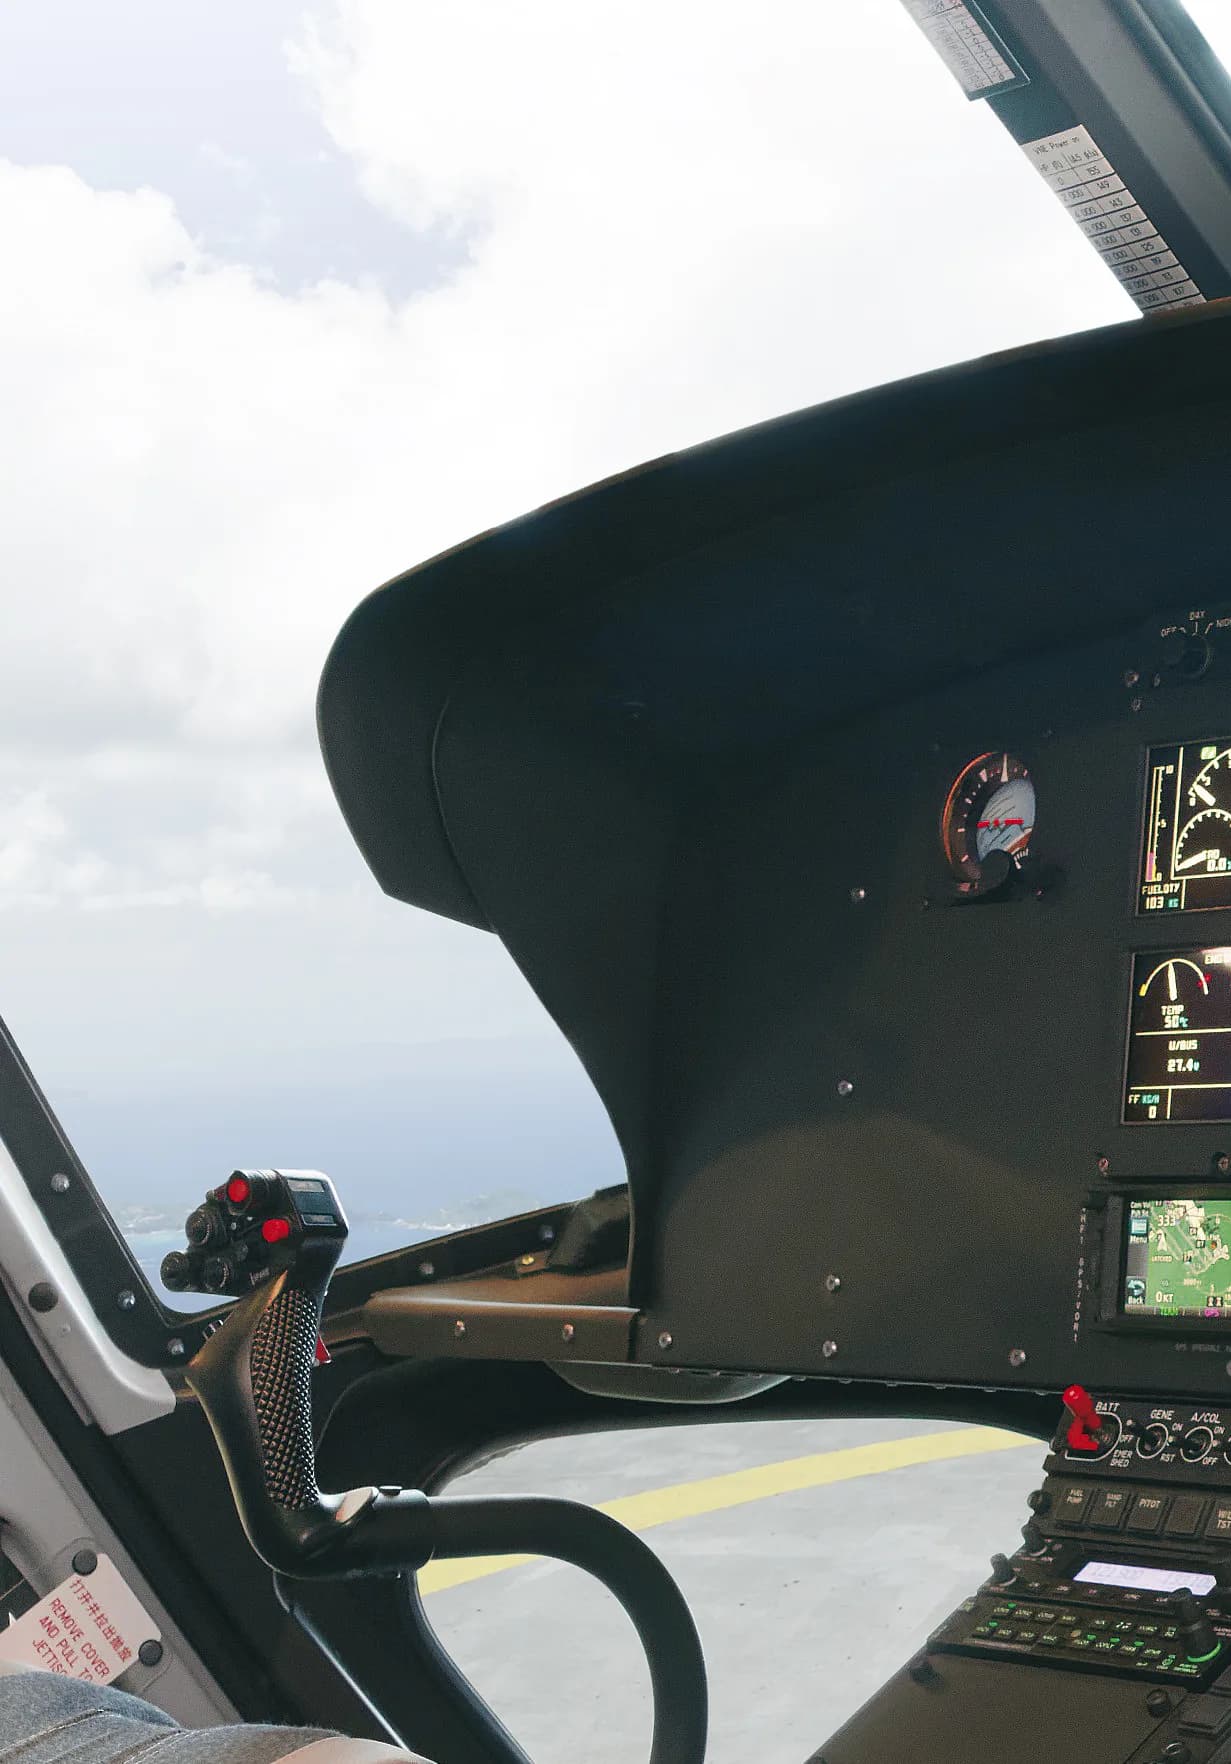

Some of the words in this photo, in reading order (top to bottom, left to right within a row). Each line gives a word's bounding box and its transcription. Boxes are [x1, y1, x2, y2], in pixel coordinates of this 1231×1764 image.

[1146, 896, 1164, 910] 103
[1161, 1004, 1184, 1016] TEMP
[1096, 1402, 1120, 1412] BATT
[1150, 1409, 1174, 1420] GENE
[1191, 1411, 1220, 1424] A/COL
[1172, 1422, 1184, 1431] ON
[1214, 1426, 1225, 1434] ON
[1202, 1457, 1218, 1466] OFF
[1138, 1498, 1161, 1509] PITOT
[1217, 1520, 1231, 1528] TST
[39, 1615, 60, 1639] AND
[56, 1638, 80, 1669] PULL
[49, 1597, 85, 1642] REMOVE
[80, 1642, 110, 1678] COVER
